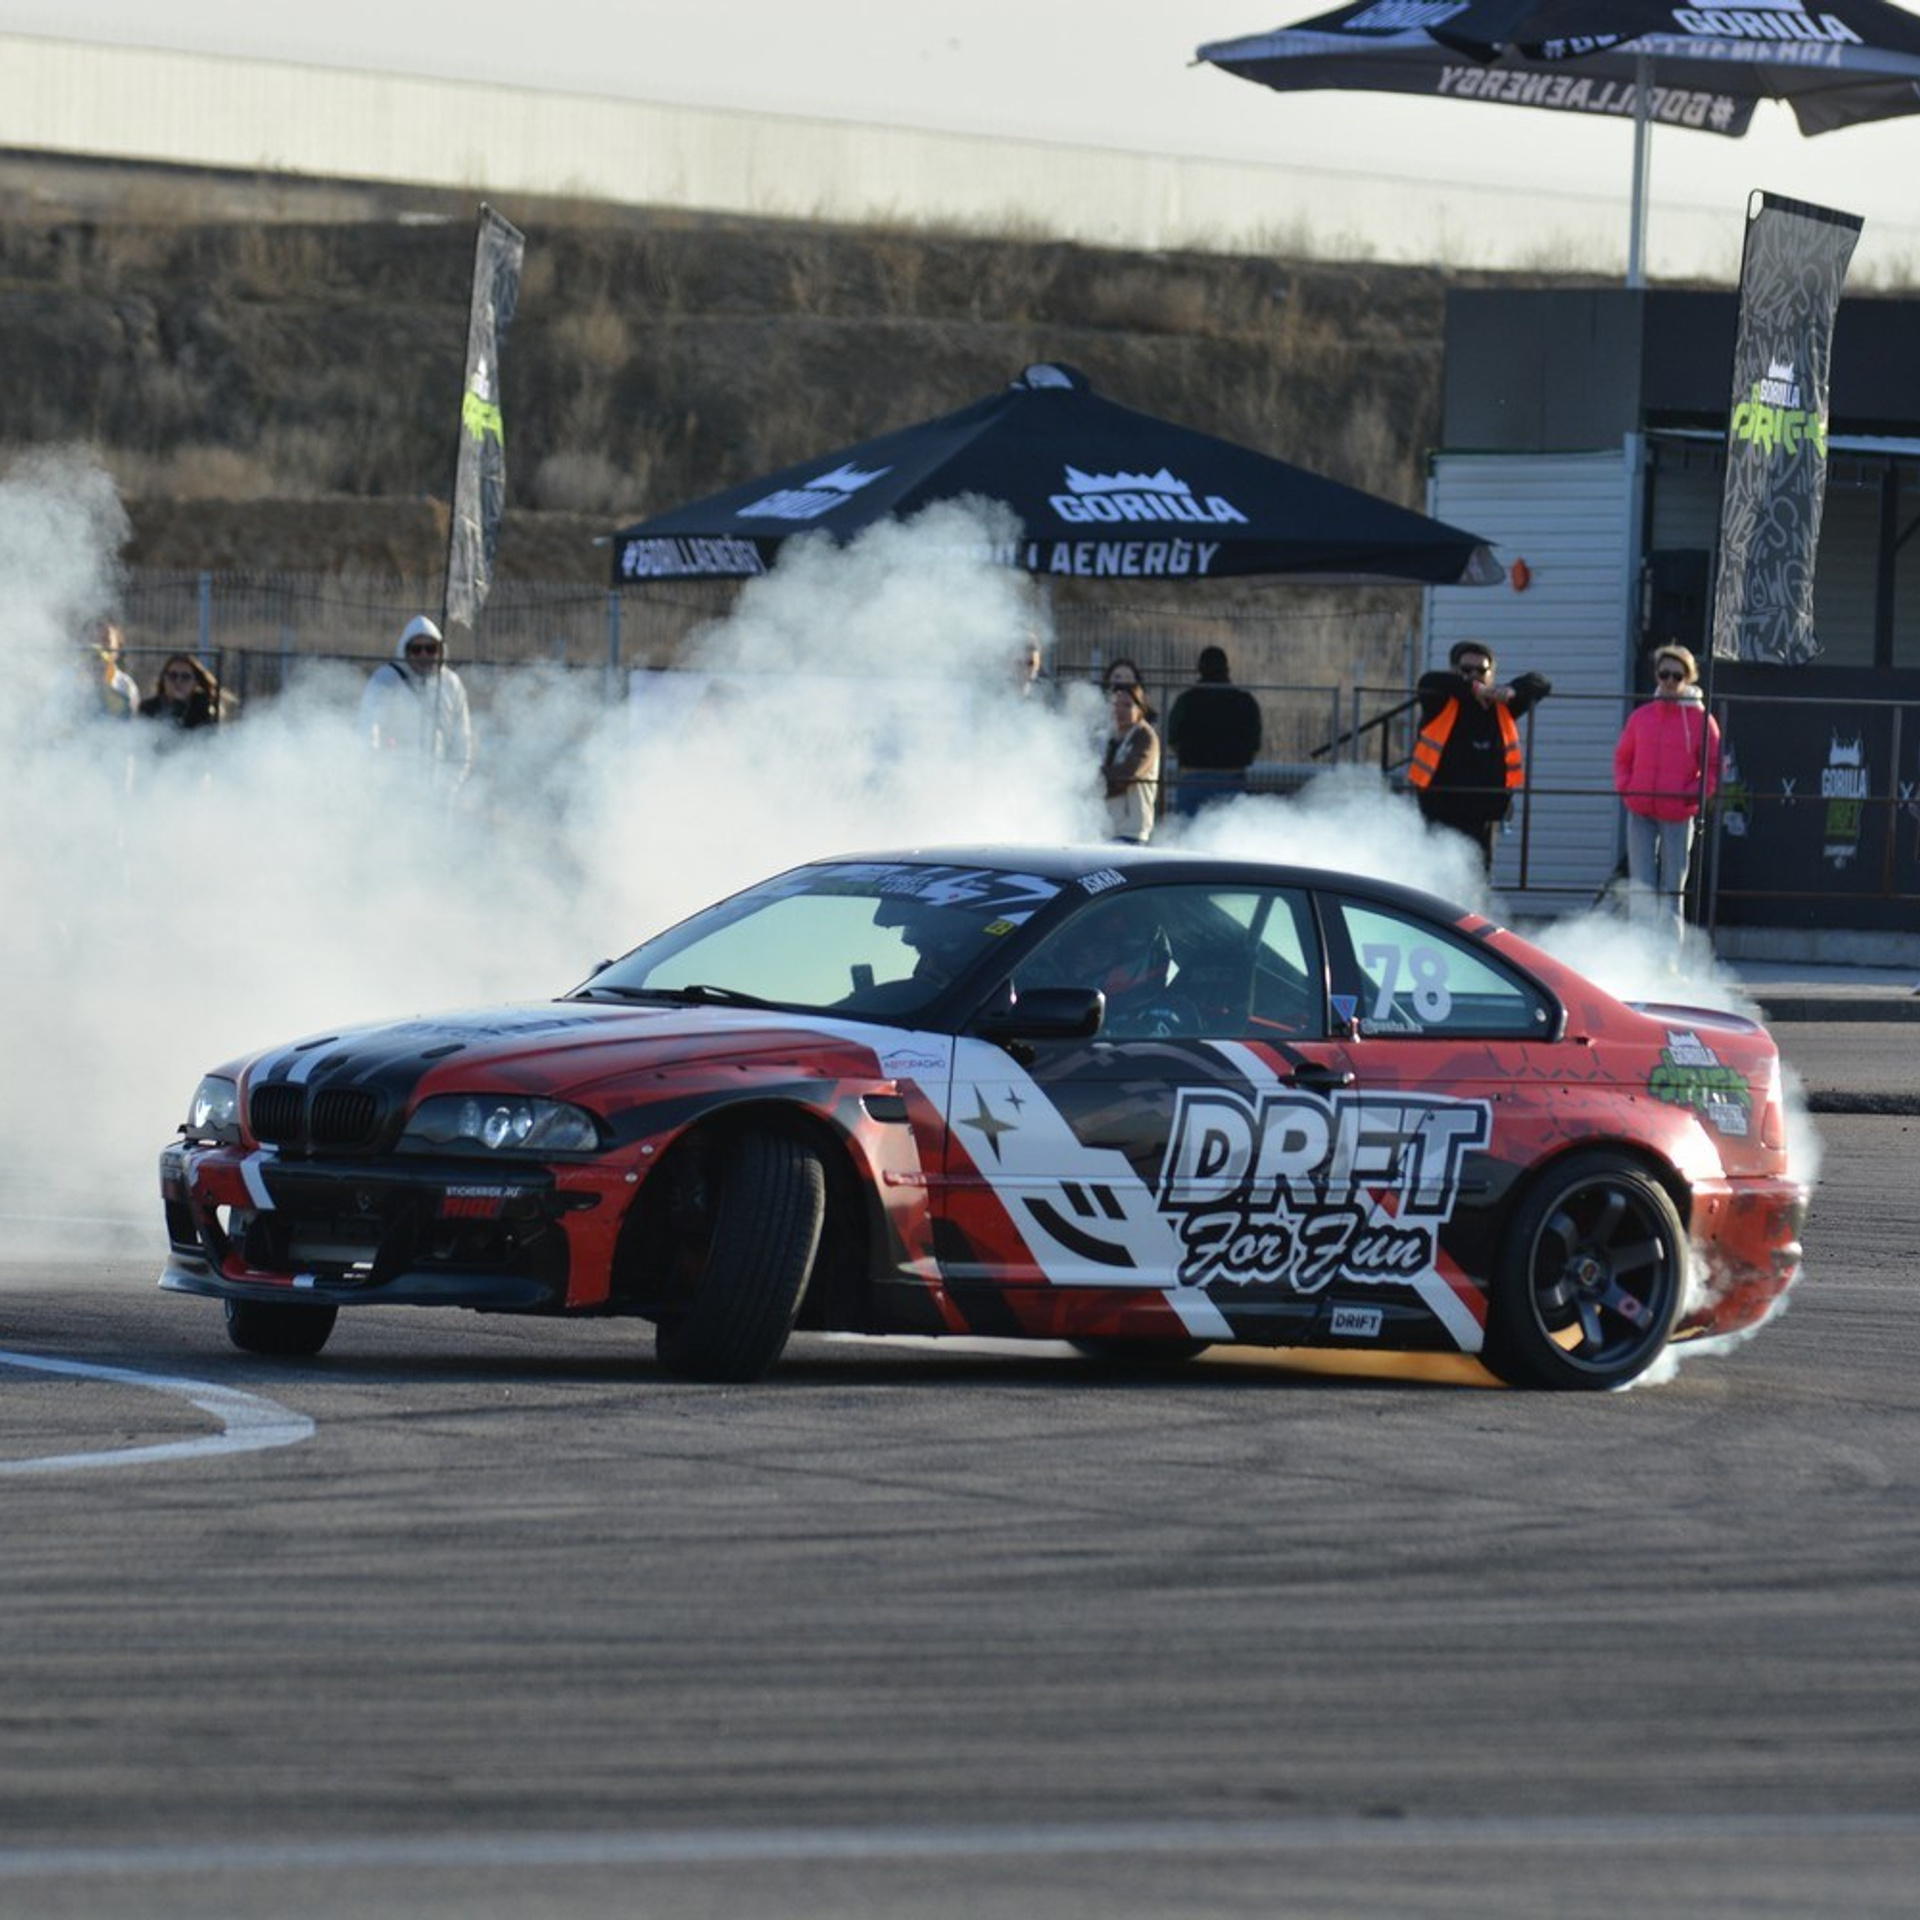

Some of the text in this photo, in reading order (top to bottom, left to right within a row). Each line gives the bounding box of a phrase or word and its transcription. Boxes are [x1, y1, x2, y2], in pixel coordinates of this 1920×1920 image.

[1671, 9, 1863, 44] GORILLA
[1760, 378, 1800, 409] GORILLA
[1049, 494, 1249, 523] GORILLA
[1821, 769, 1867, 799] GORILLA
[1362, 943, 1452, 1022] 78
[1178, 1210, 1433, 1288] For Fun
[1334, 1313, 1380, 1328] DRIFT
